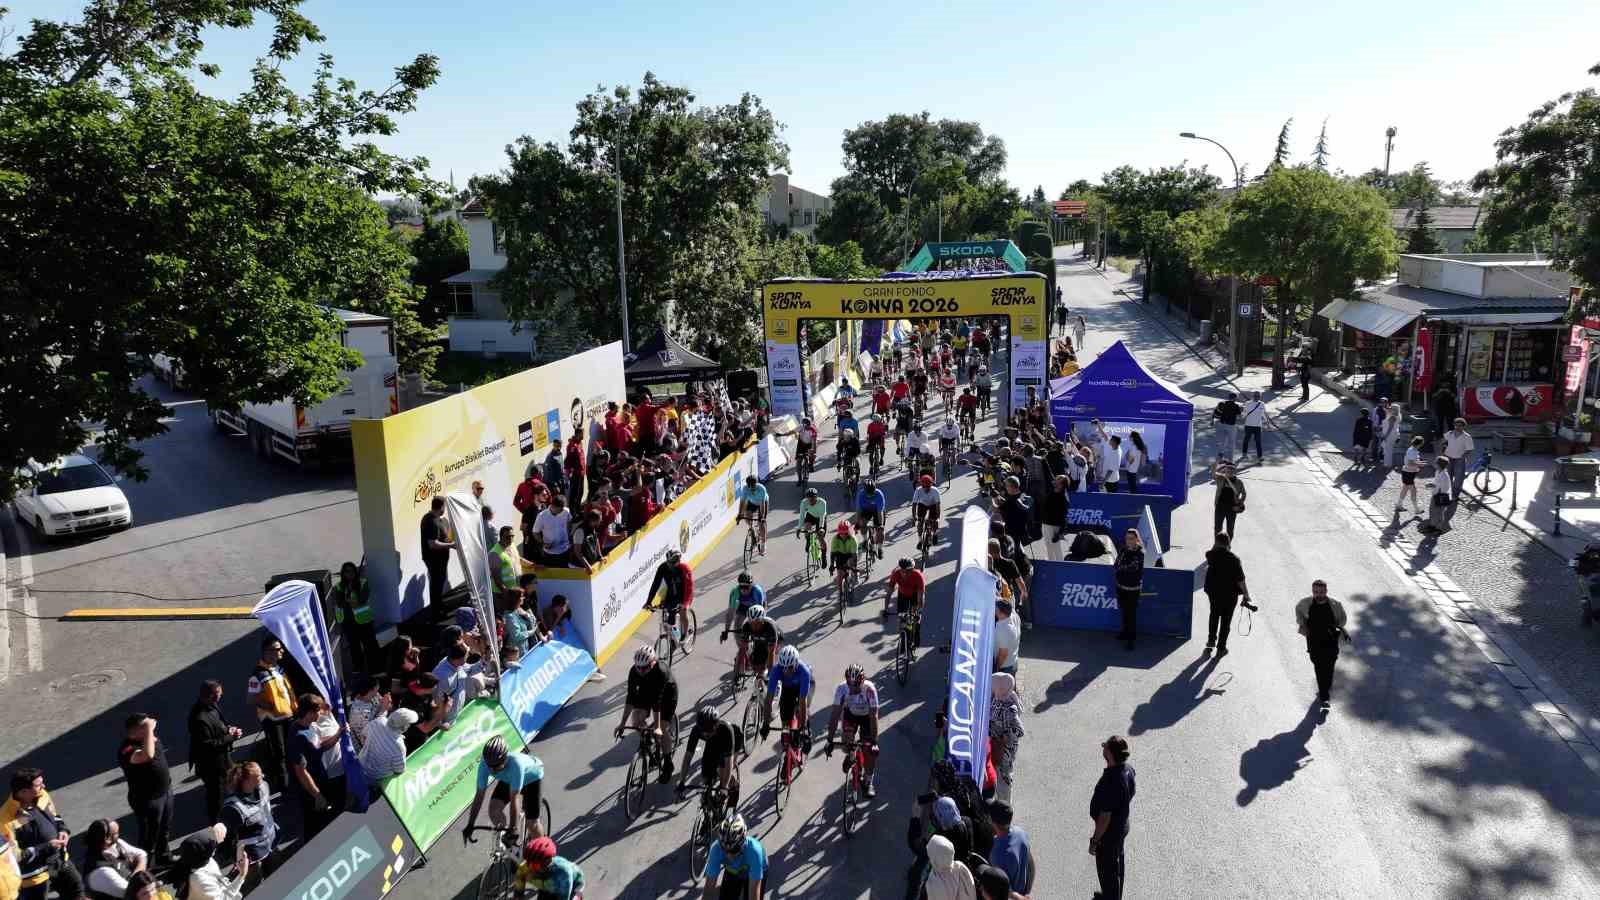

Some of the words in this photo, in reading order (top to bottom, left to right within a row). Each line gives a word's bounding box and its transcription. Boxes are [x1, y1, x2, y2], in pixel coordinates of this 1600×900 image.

[939, 246, 994, 256] SKODA
[770, 292, 802, 301] SPOR
[863, 287, 894, 297] GRAN
[896, 286, 936, 297] FONDO
[991, 287, 1026, 297] SPOR
[770, 299, 812, 310] KONYA
[841, 299, 904, 314] KONYA
[908, 297, 960, 313] 2026
[991, 294, 1036, 306] KONYA
[1061, 583, 1107, 597] SPOR
[1061, 592, 1119, 609] KONYA
[404, 708, 497, 810] MOSSO
[301, 846, 372, 900] ODA
